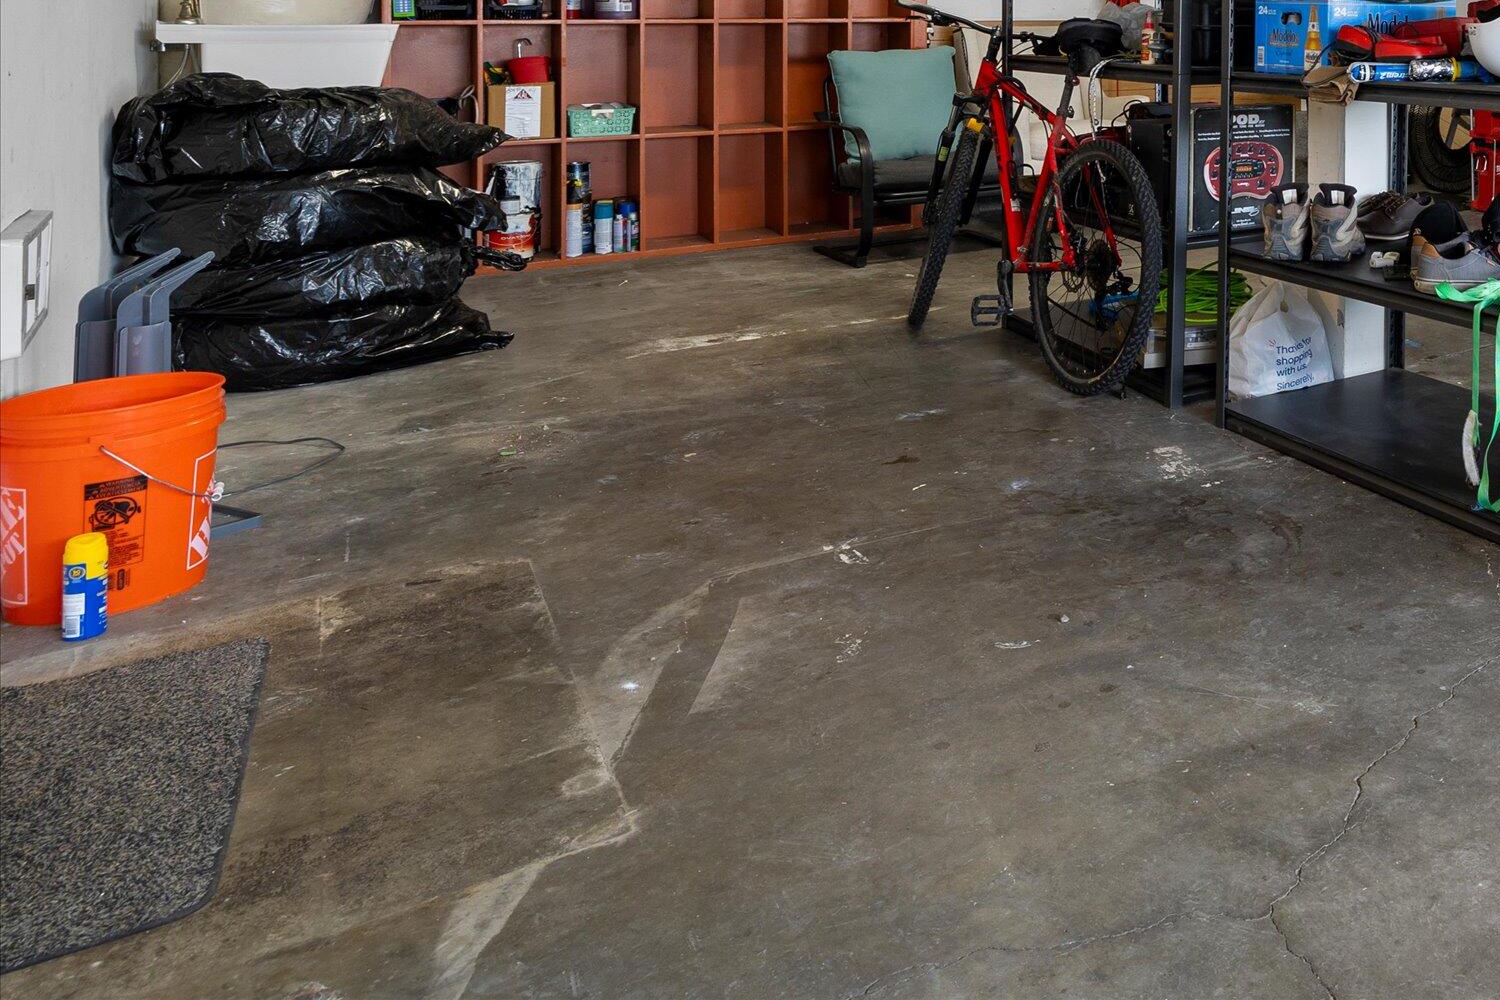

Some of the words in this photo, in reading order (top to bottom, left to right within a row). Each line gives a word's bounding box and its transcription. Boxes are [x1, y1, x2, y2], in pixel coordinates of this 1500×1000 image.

[1334, 7, 1347, 17] 24
[1232, 114, 1260, 125] OD
[1276, 342, 1304, 355] Thanks
[1276, 348, 1313, 366] shopping
[1276, 366, 1295, 377] with
[1277, 373, 1315, 391] Sincerely,
